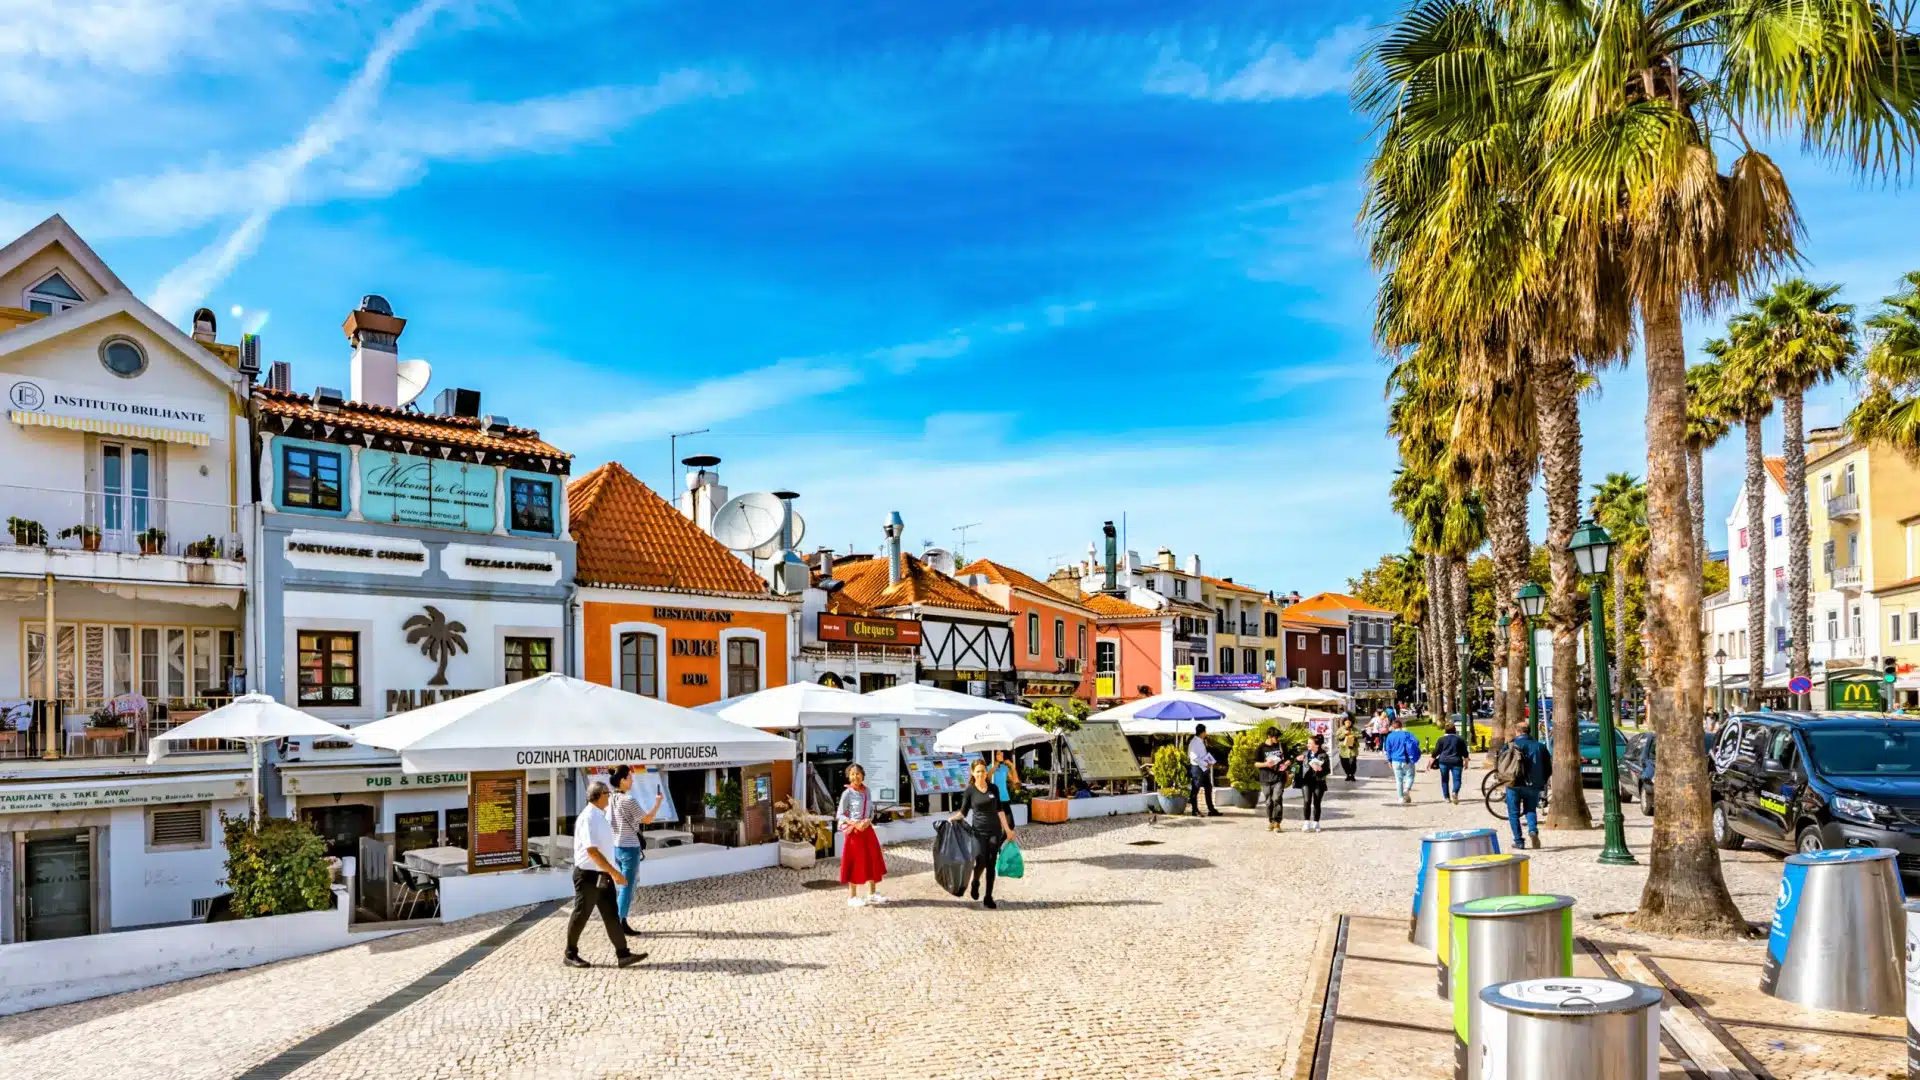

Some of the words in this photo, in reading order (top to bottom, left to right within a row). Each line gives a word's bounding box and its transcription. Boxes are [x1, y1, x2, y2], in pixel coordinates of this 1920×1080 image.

[54, 395, 127, 413] INSTITUTO
[131, 405, 206, 422] BRILHANTE
[367, 463, 436, 491] Welcome
[449, 484, 488, 498] Cascais
[383, 491, 406, 499] VINDOS
[288, 542, 374, 558] PORTUGUESE
[377, 549, 425, 562] CUISINE
[654, 607, 735, 623] RESTAURANT
[853, 621, 896, 637] Chequers
[672, 638, 719, 657] DUKE
[682, 673, 708, 685] PUB
[517, 751, 570, 765] COZINHA
[573, 748, 647, 763] TRADICIONAL
[650, 745, 718, 760] PORTUGUESA
[366, 776, 392, 787] PUB
[400, 777, 409, 785] &
[51, 800, 88, 808] Speciality
[119, 796, 148, 804] Suckling
[60, 792, 67, 800] &
[73, 790, 98, 799] TAKE
[104, 788, 130, 797] AWAY
